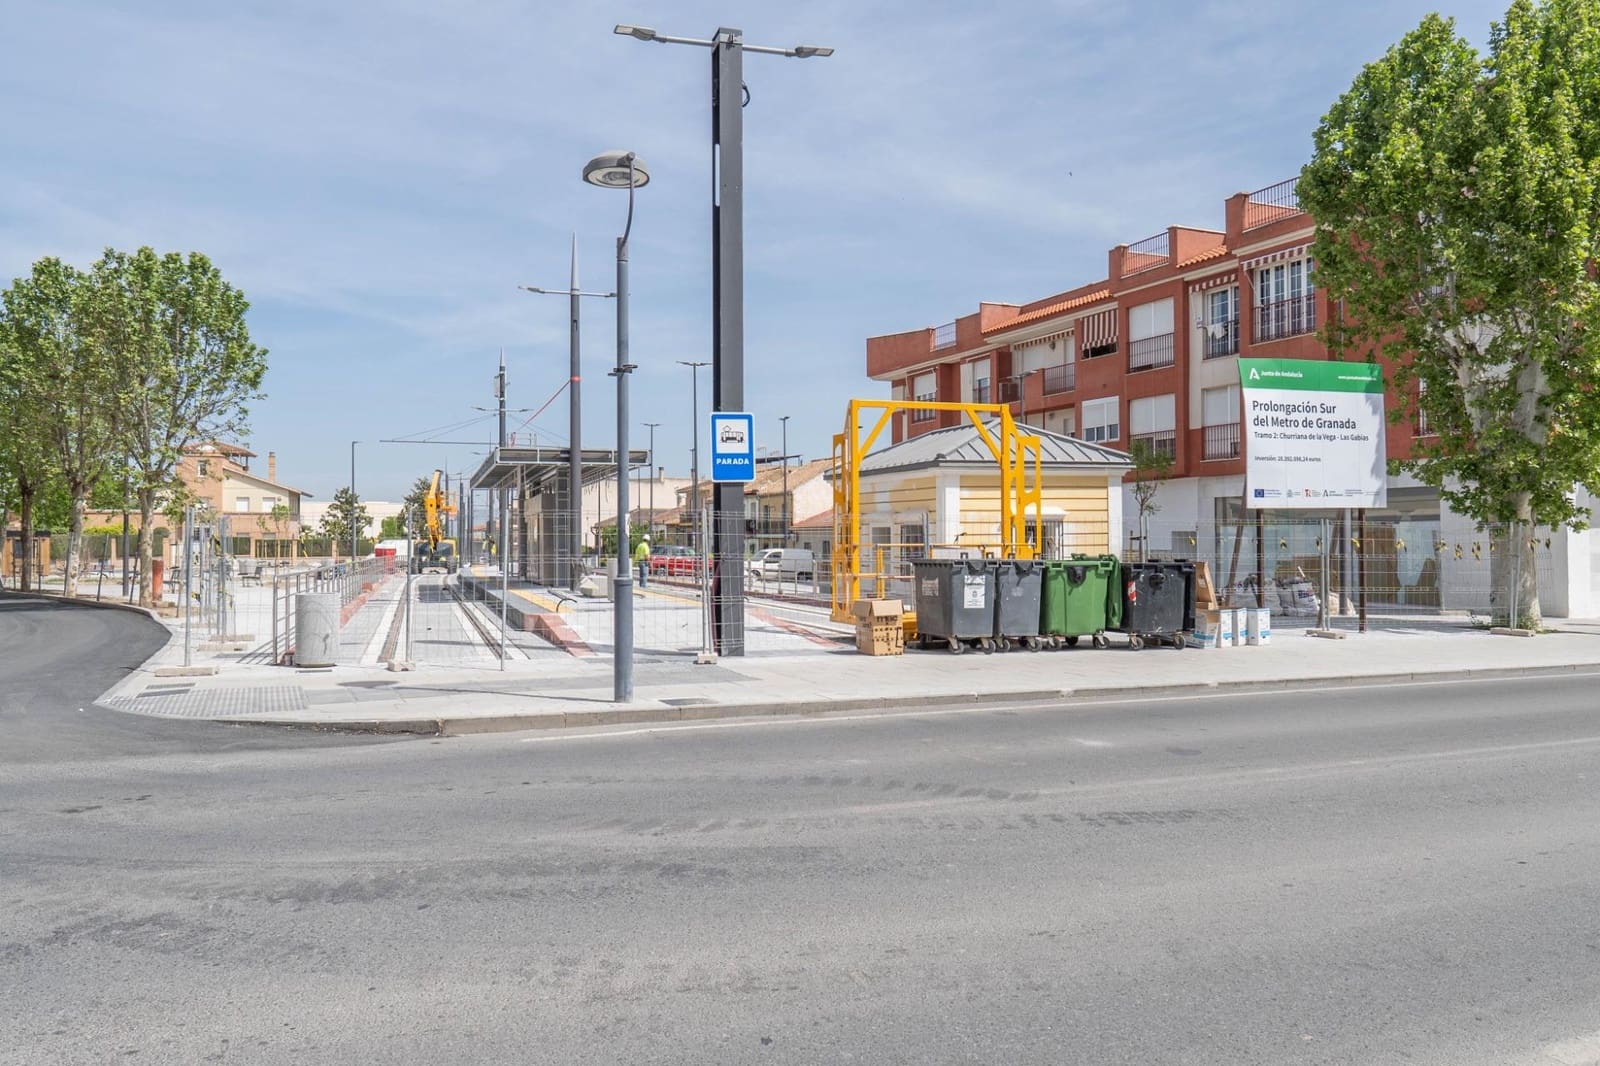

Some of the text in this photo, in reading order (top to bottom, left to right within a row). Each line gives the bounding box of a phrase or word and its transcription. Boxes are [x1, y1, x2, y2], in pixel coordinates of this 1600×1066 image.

[1252, 401, 1337, 415] Prolongación Sur
[1253, 416, 1357, 429] del Metro de Granada
[1322, 434, 1336, 442] Vega
